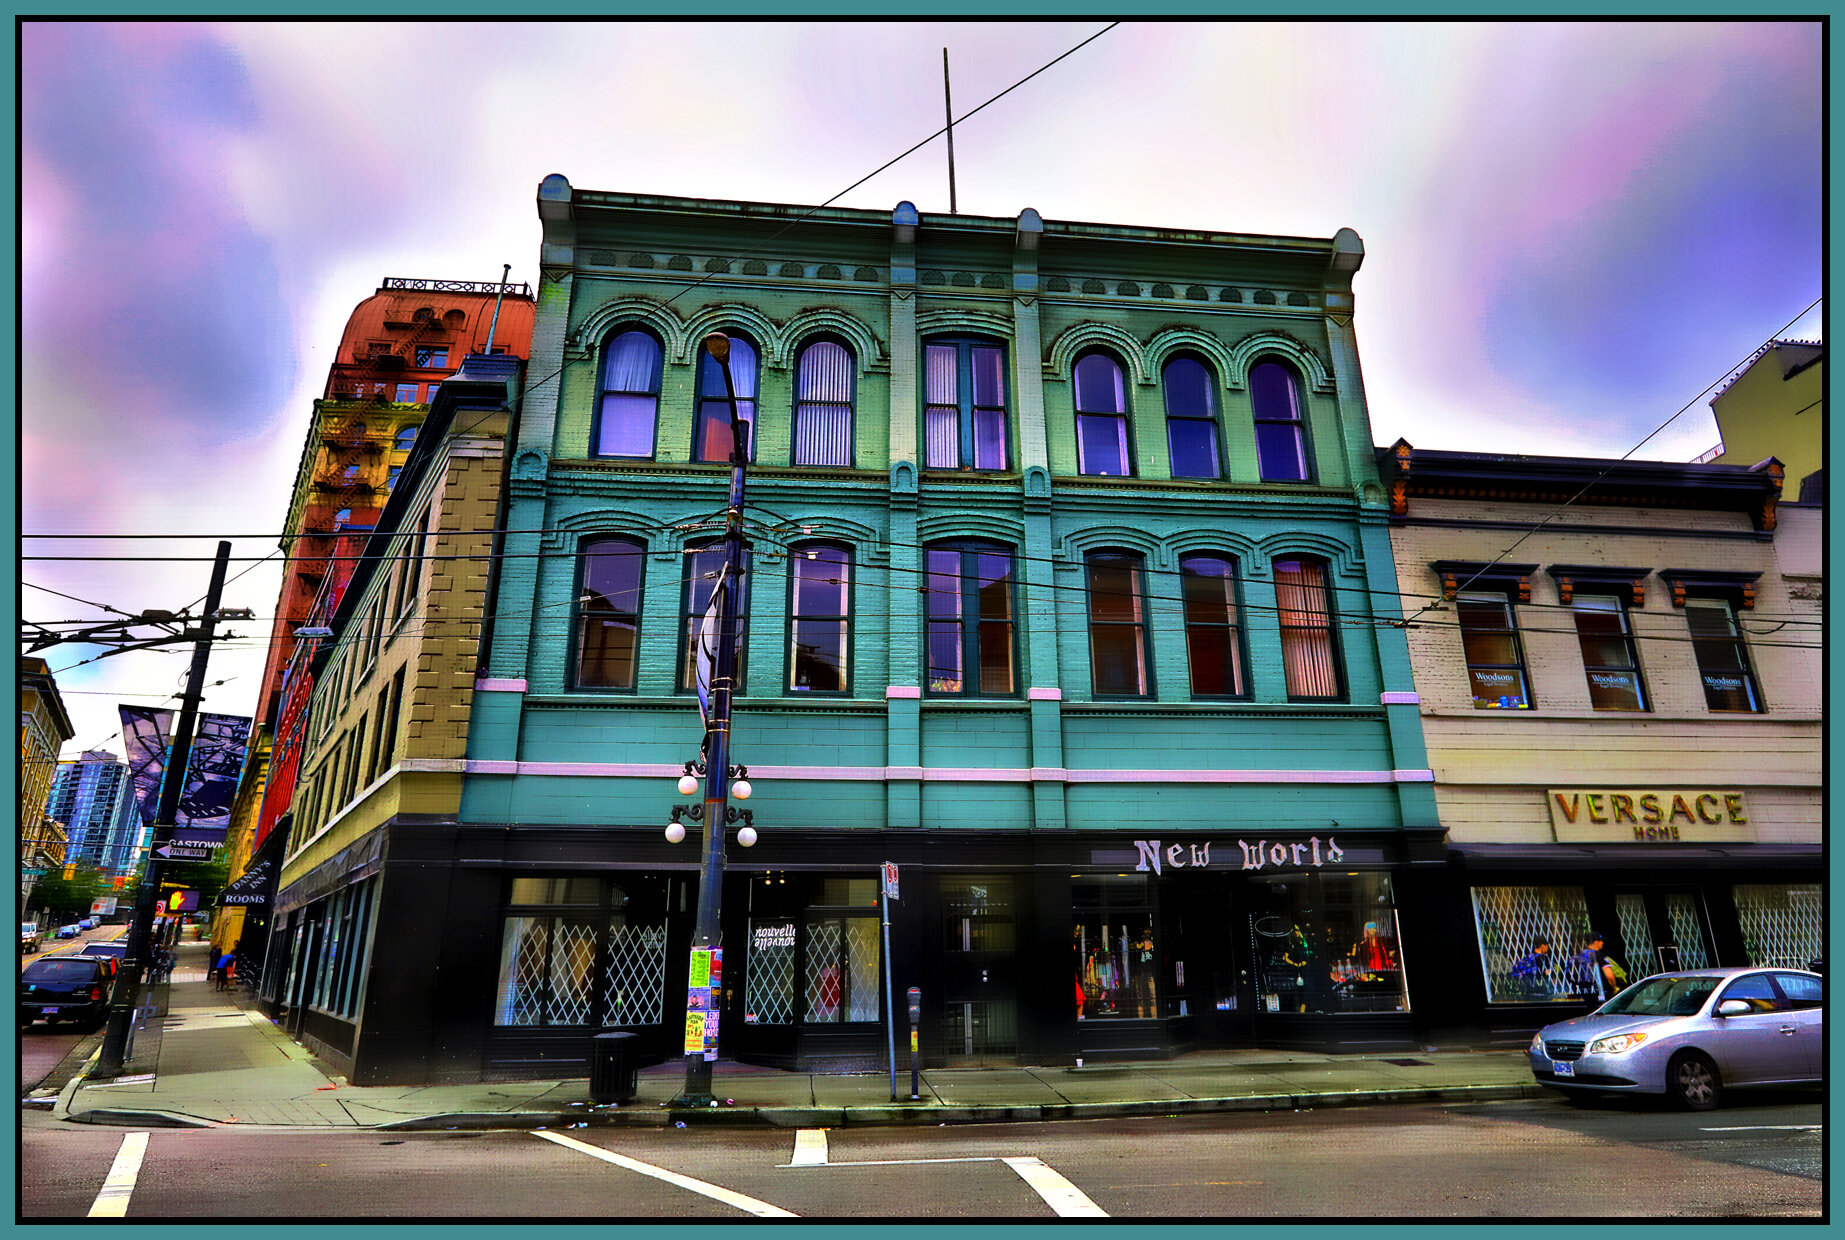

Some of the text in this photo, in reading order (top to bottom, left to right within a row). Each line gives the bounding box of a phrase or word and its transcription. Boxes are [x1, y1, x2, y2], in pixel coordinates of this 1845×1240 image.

[1475, 672, 1514, 681] Woodsons
[1591, 674, 1630, 683] Woodsons
[1704, 676, 1742, 685] Woodsons
[1555, 793, 1748, 824] VERSACE
[1633, 826, 1681, 841] HOME
[169, 839, 225, 848] GASTOWN
[169, 848, 206, 857] ONE WAY
[1134, 836, 1344, 876] New World
[232, 860, 271, 890] DANNY'S
[249, 874, 267, 889] INN
[225, 895, 265, 903] ROOMS
